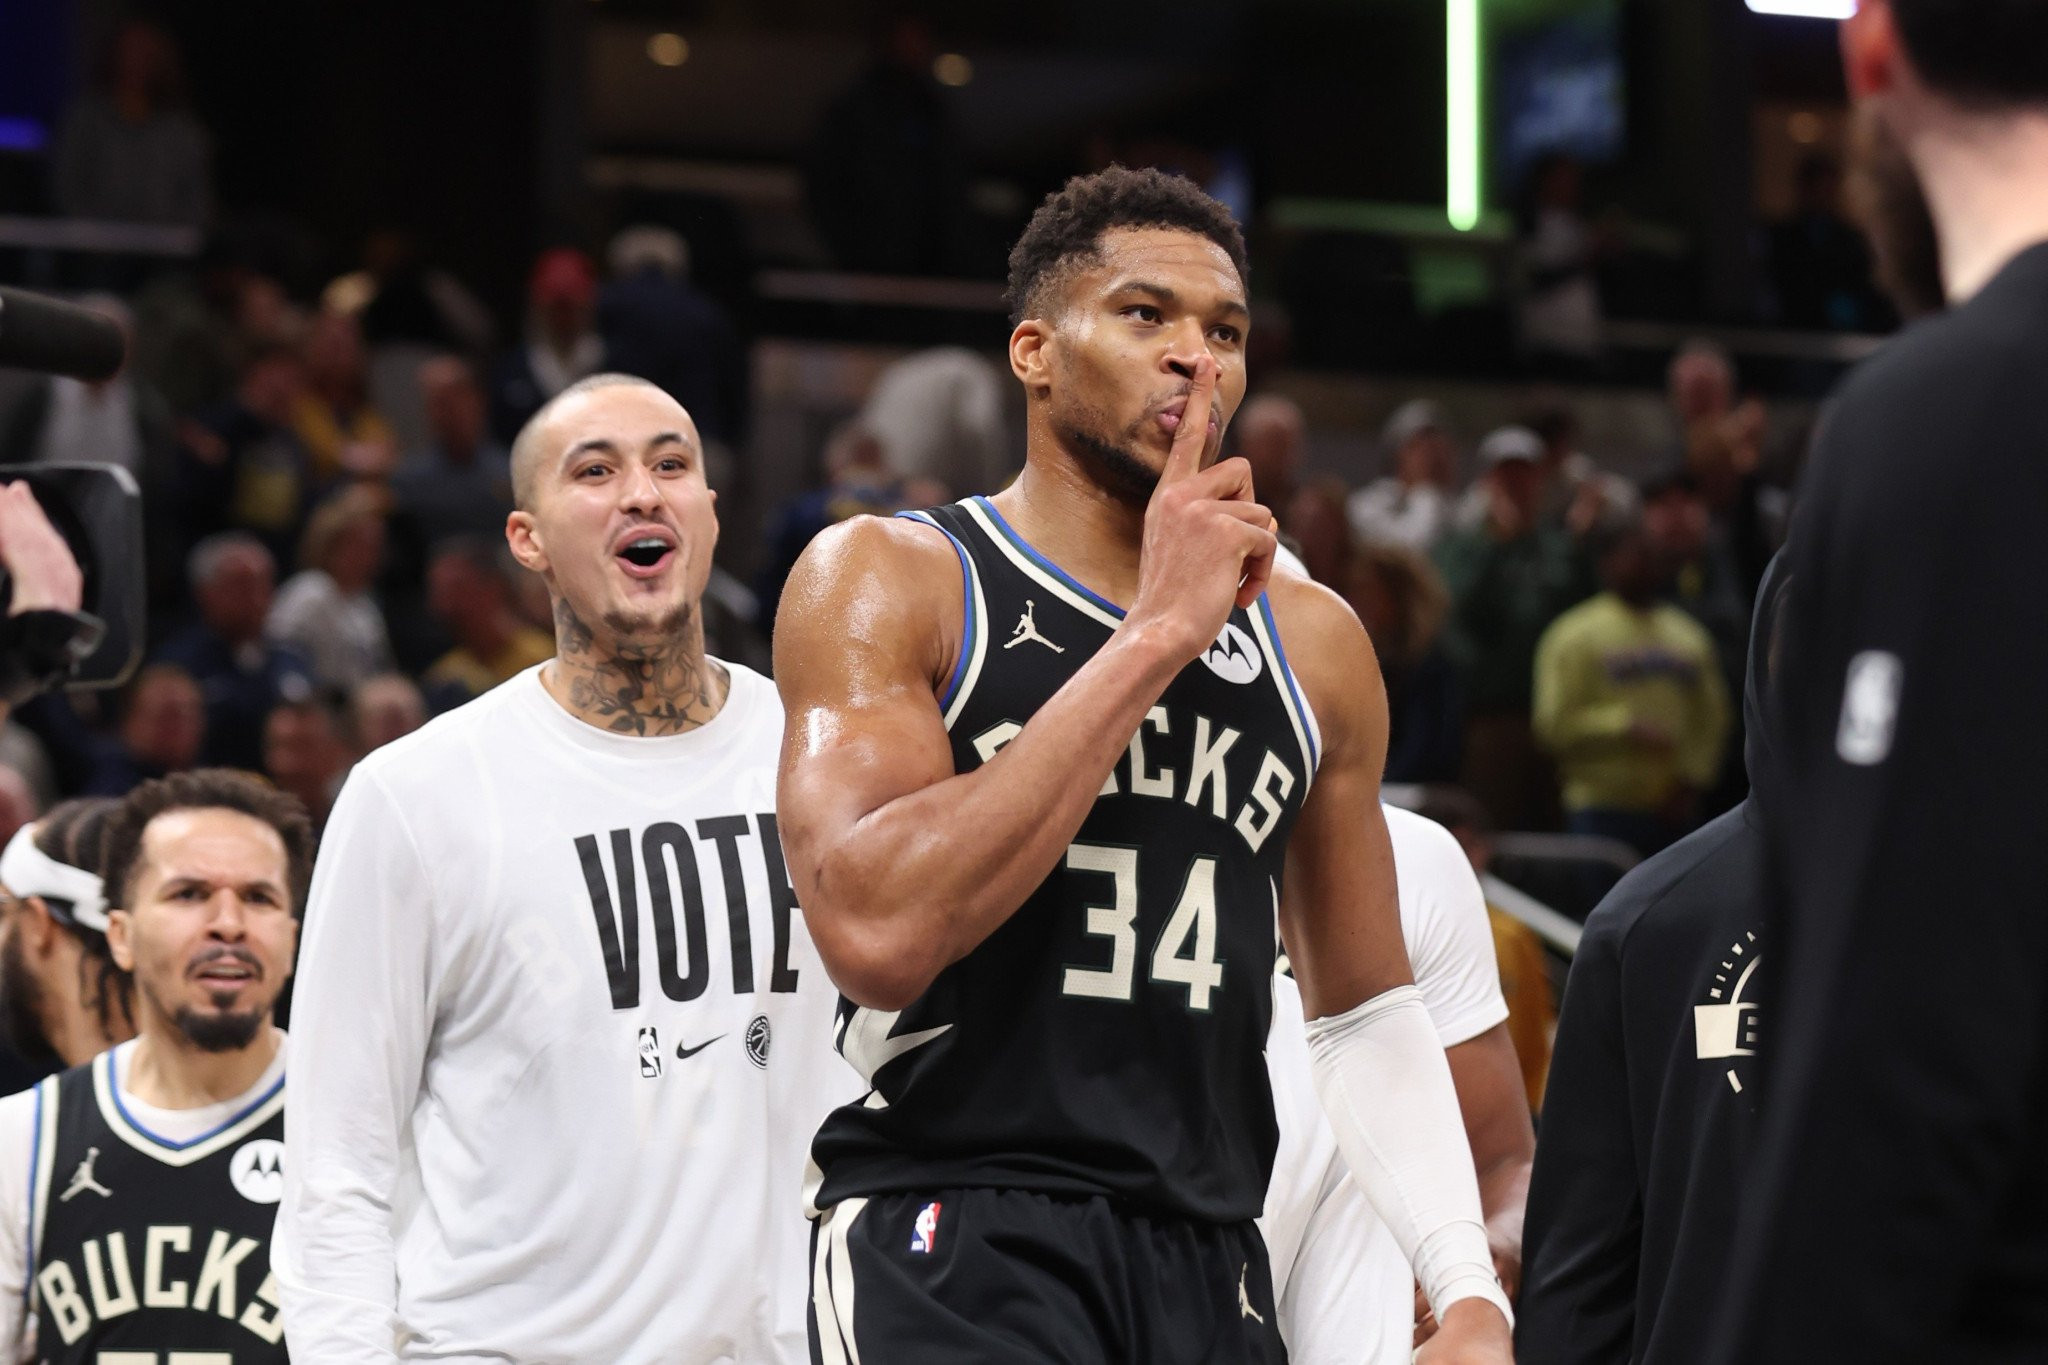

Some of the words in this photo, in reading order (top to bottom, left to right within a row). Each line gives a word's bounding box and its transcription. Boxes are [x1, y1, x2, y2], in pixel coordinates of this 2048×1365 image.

[972, 705, 1296, 853] CKS
[574, 812, 800, 1010] VOTE
[1062, 843, 1223, 1010] 34
[37, 1225, 285, 1346] BUCKS
